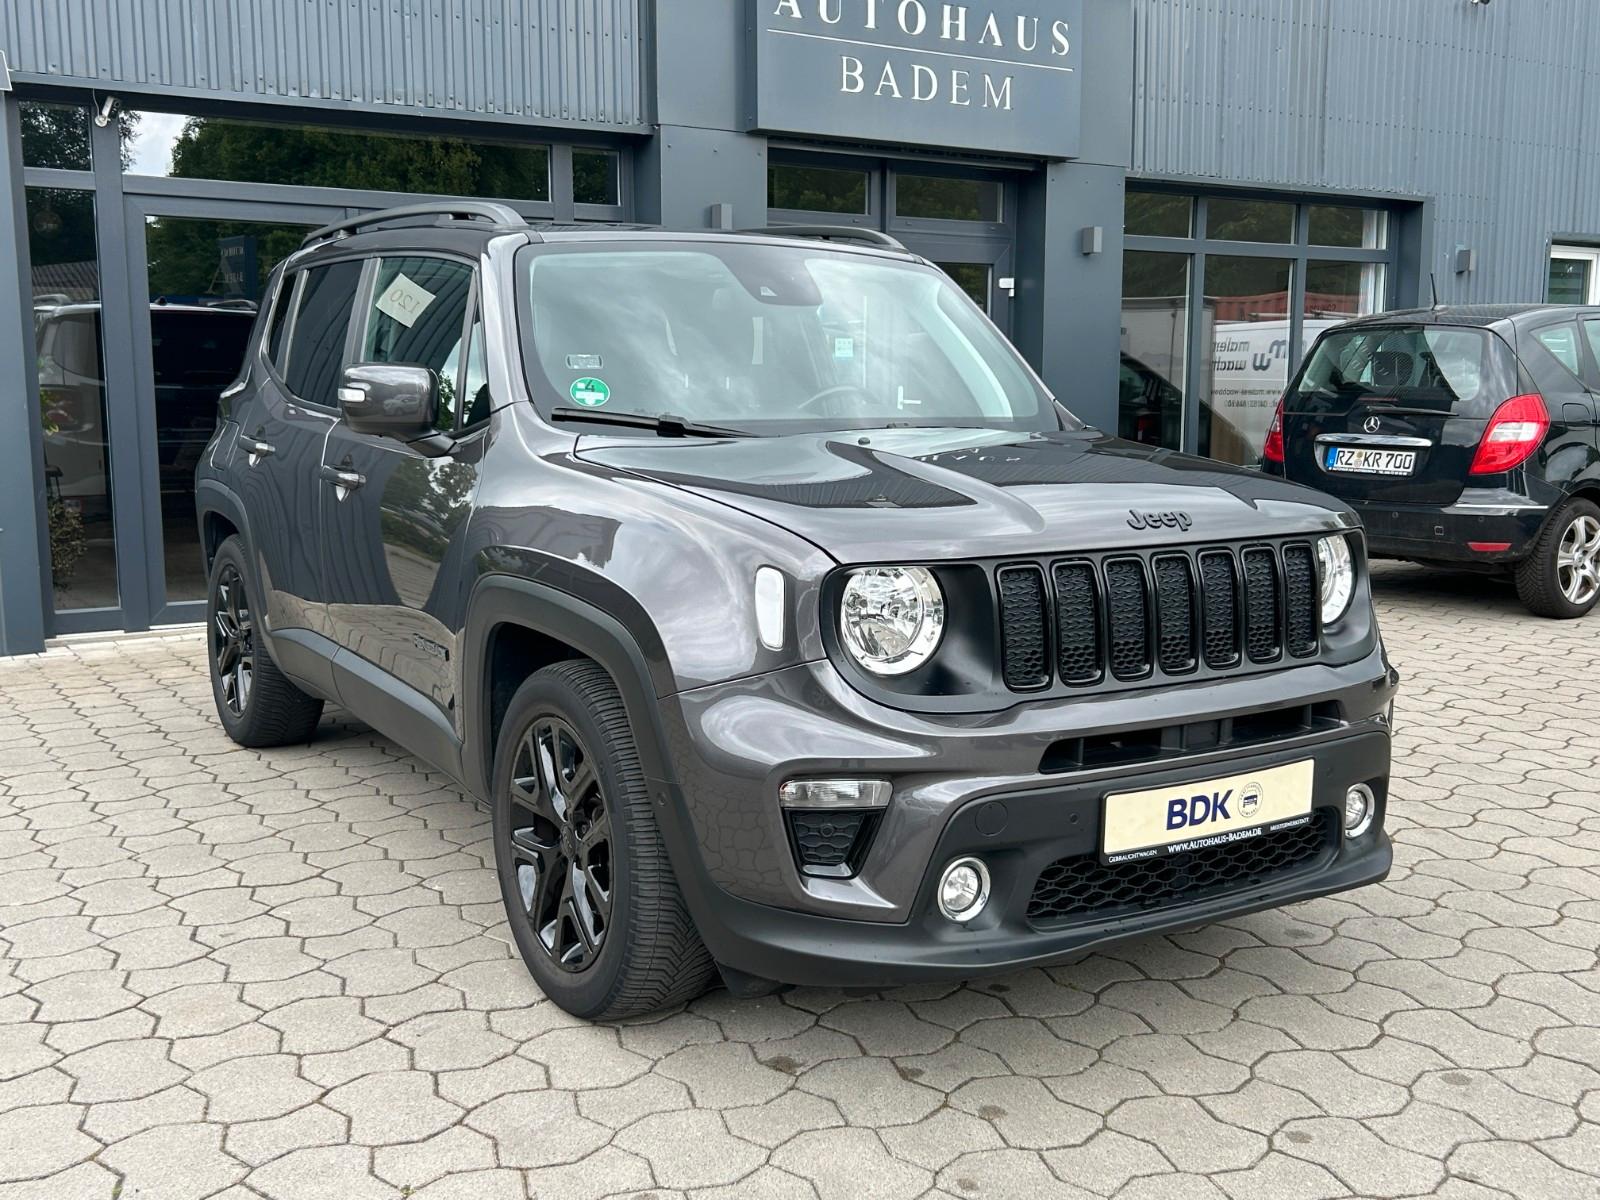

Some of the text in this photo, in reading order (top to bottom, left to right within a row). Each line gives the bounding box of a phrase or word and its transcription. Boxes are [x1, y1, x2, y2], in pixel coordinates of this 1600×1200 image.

[840, 55, 1014, 110] BADEM
[584, 379, 596, 392] 4
[1335, 450, 1413, 470] RZ KR 700
[1126, 509, 1193, 532] Jeep
[1166, 789, 1234, 831] BDK
